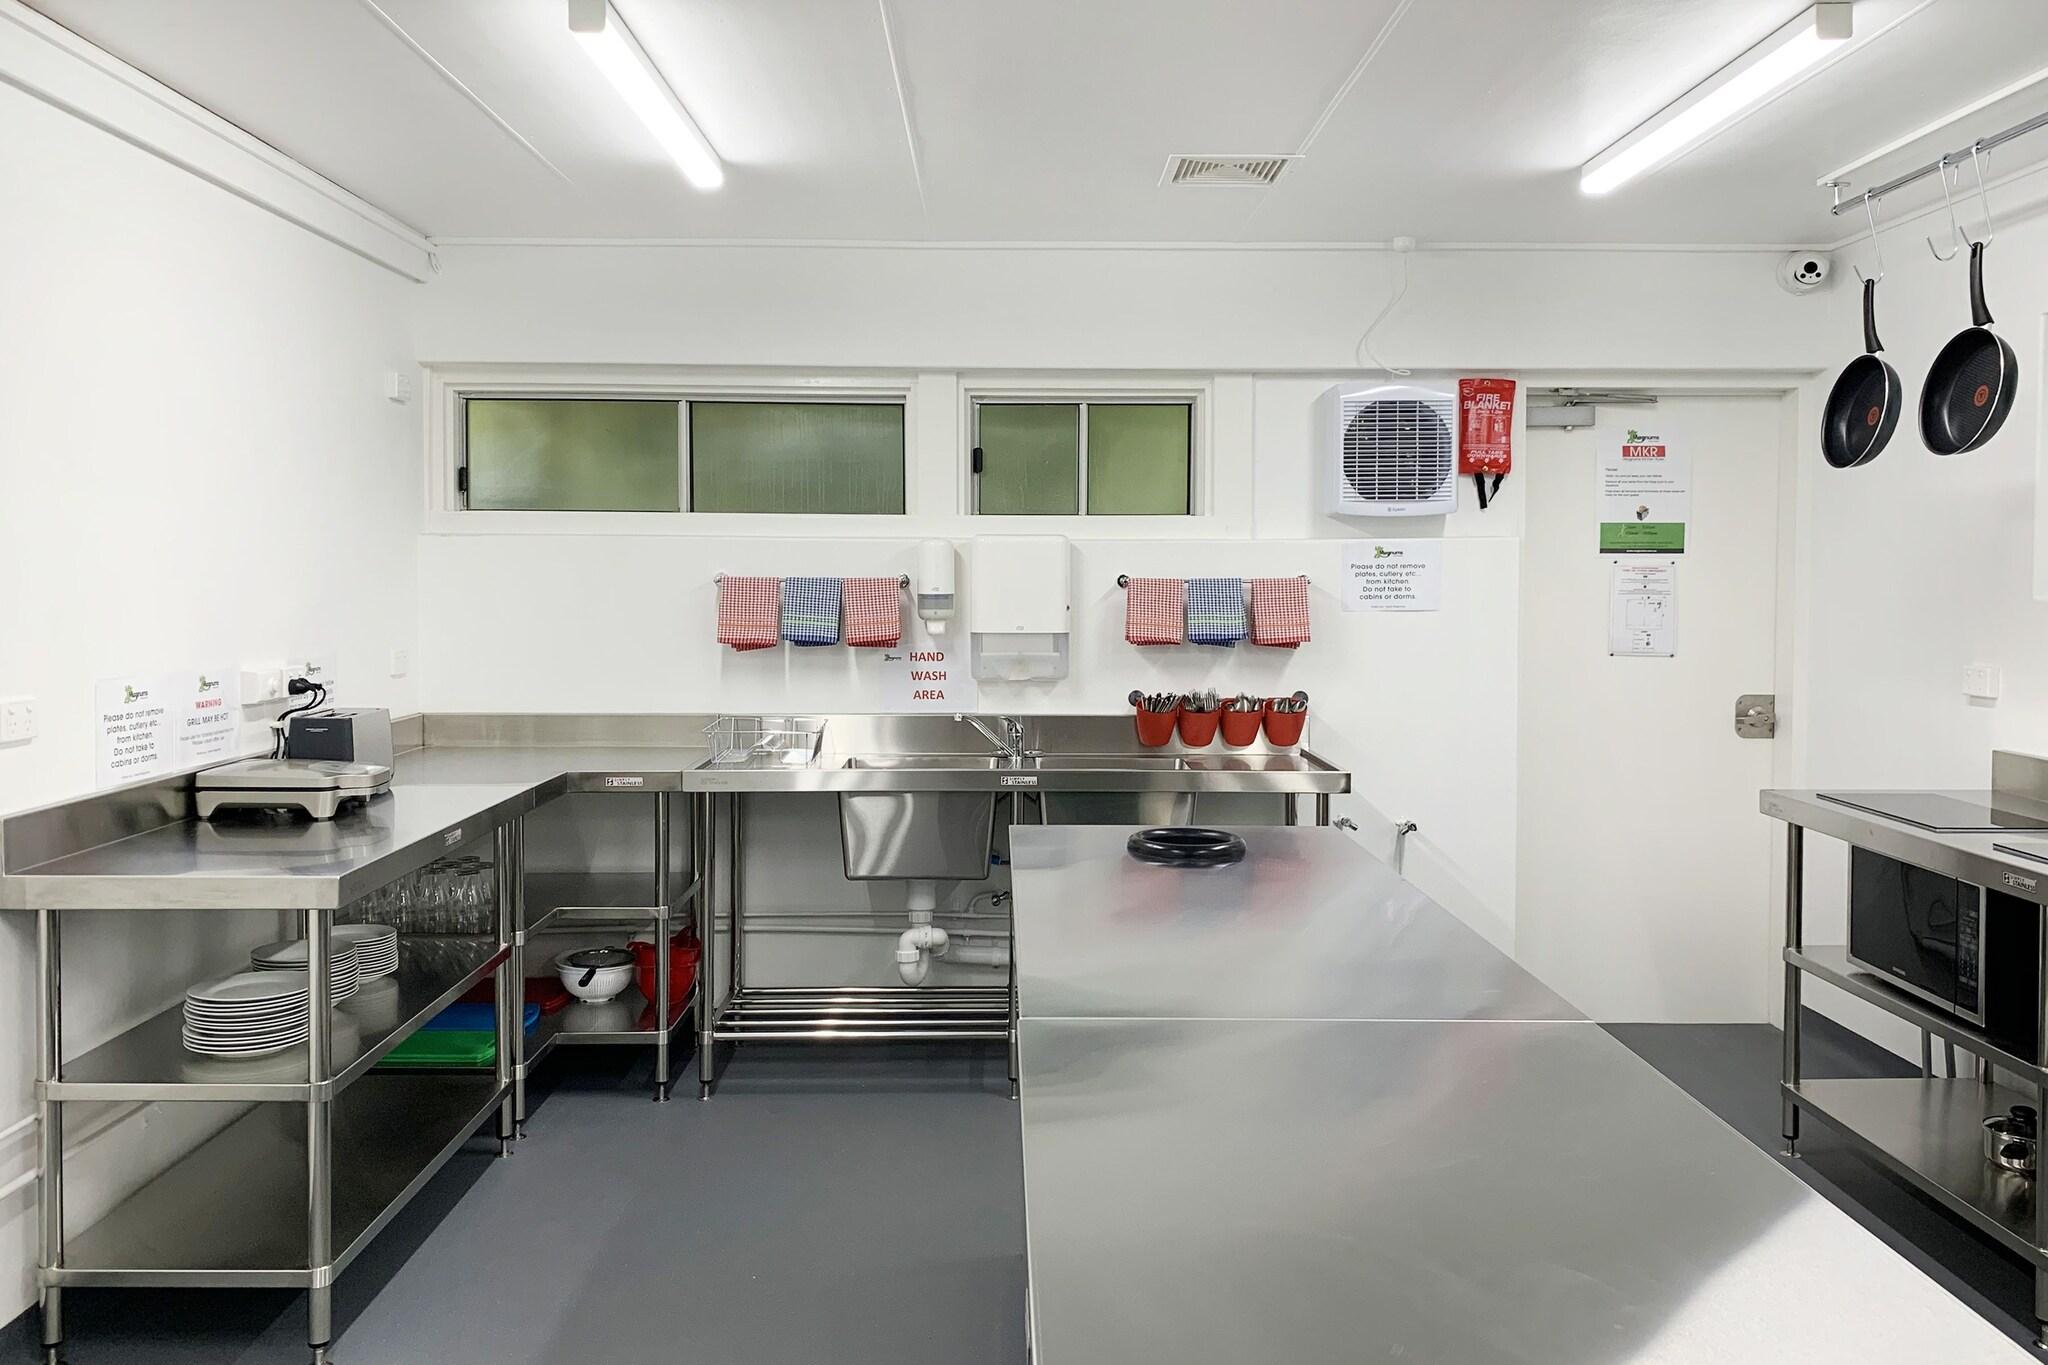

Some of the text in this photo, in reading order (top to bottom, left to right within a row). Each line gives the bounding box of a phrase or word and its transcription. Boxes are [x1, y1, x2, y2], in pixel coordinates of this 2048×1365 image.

[1476, 393, 1500, 401] FIRE
[1464, 400, 1511, 410] BLANKET
[1630, 446, 1658, 457] MKR
[910, 652, 944, 661] HAND
[911, 671, 947, 681] WASH
[913, 690, 945, 700] AREA
[196, 698, 222, 709] WARNING
[103, 707, 164, 723] Please do not remove
[187, 712, 229, 726] GRILL MAY BE HOT
[129, 721, 148, 731] cutlery
[117, 735, 131, 744] from
[114, 747, 123, 756] Do
[125, 746, 134, 754] not
[136, 744, 148, 752] take
[110, 758, 132, 768] cabins
